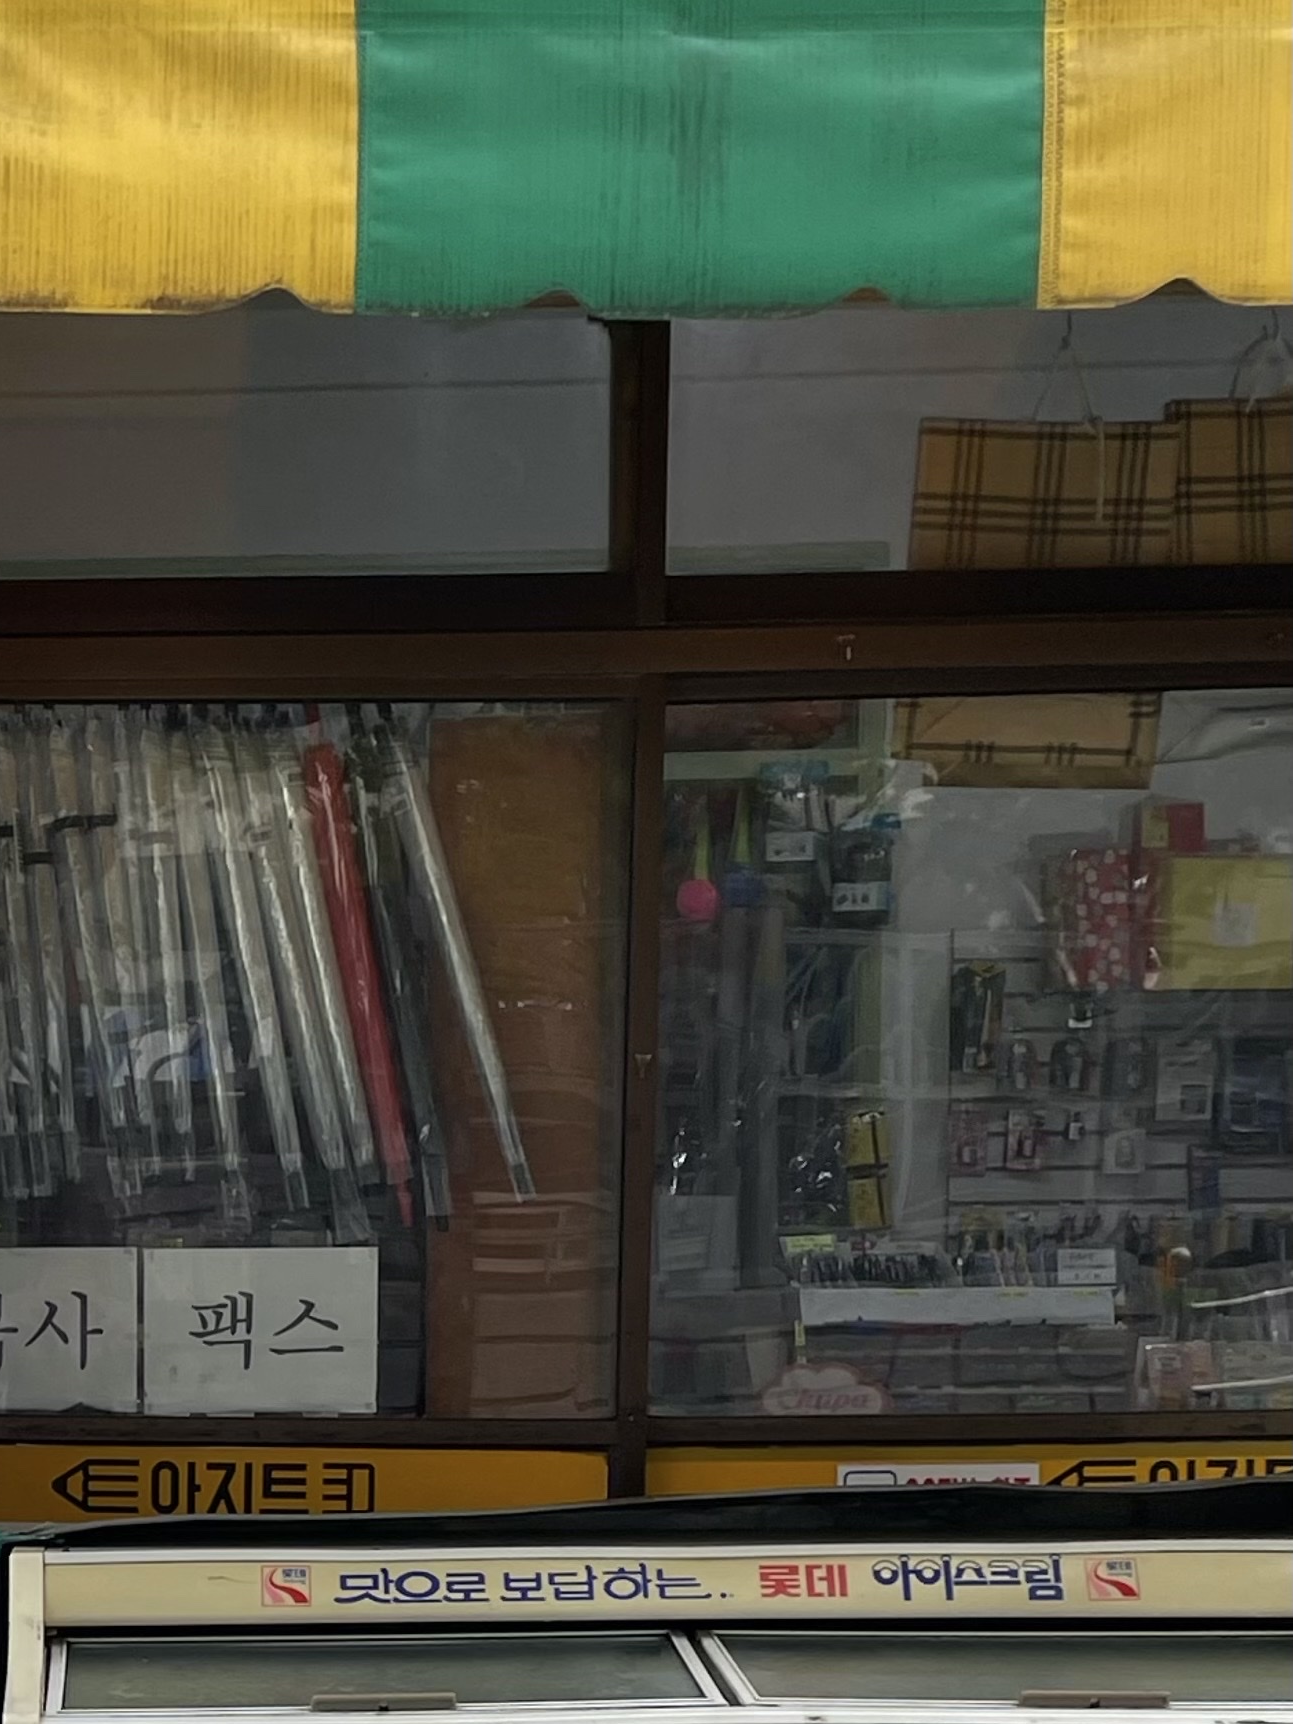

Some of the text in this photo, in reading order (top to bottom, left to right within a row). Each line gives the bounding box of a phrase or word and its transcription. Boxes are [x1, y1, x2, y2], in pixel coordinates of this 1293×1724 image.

[189, 1291, 344, 1371] 팩스
[333, 1567, 490, 1604] 맛으로
[758, 1564, 848, 1598] 롯데
[872, 1554, 1064, 1601] 아이스크림
